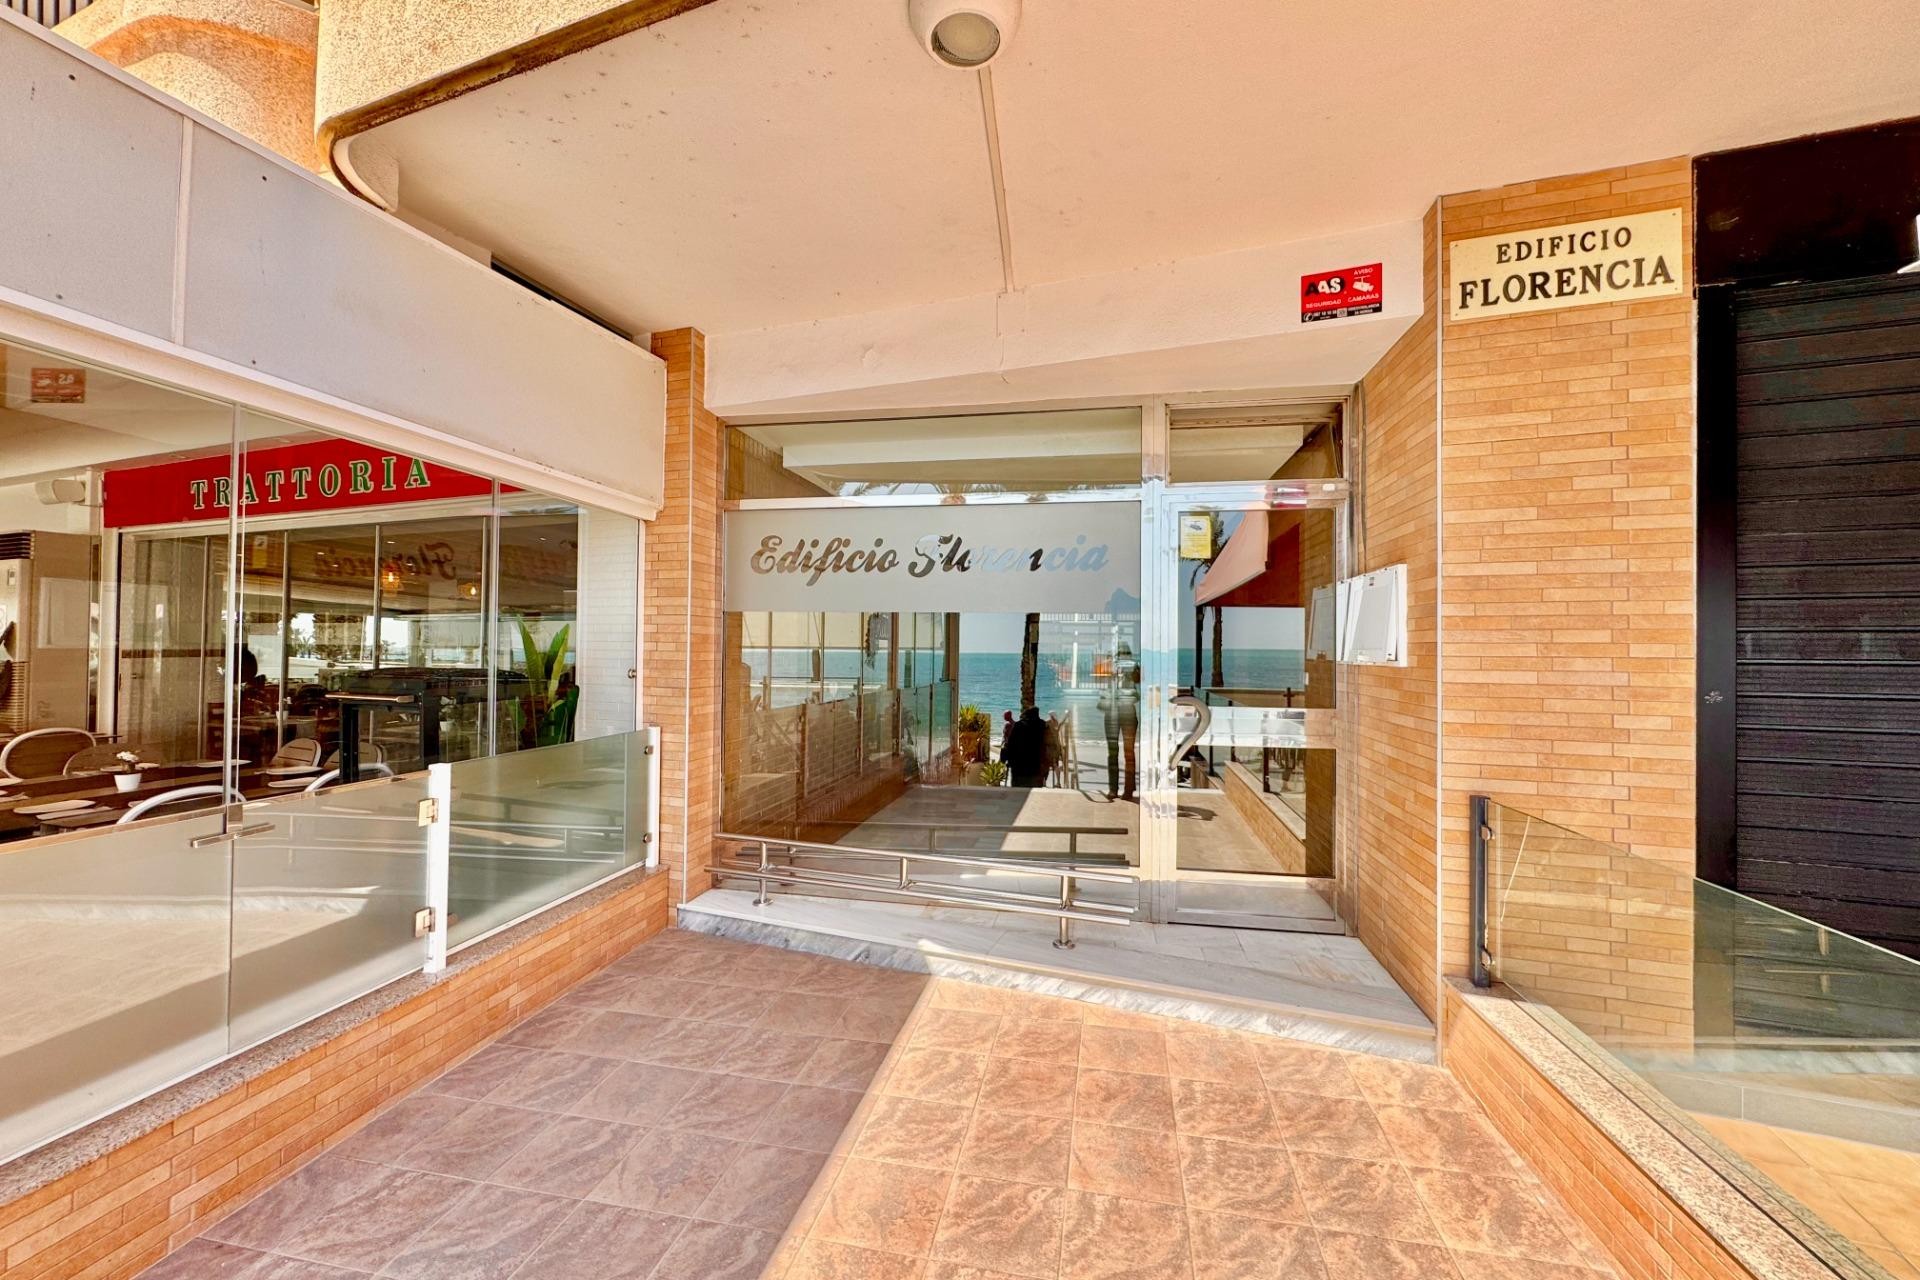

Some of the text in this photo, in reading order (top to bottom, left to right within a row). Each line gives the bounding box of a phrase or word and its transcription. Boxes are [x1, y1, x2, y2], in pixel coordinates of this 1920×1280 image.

[1496, 227, 1632, 264] EDIFICIO
[1305, 299, 1342, 309] SEGURIDAD
[1347, 293, 1380, 303] CAMARAS
[1458, 255, 1675, 309] FLORENCIA
[191, 456, 431, 510] TRATTORIA
[750, 533, 1110, 587] Edificio Florencia
